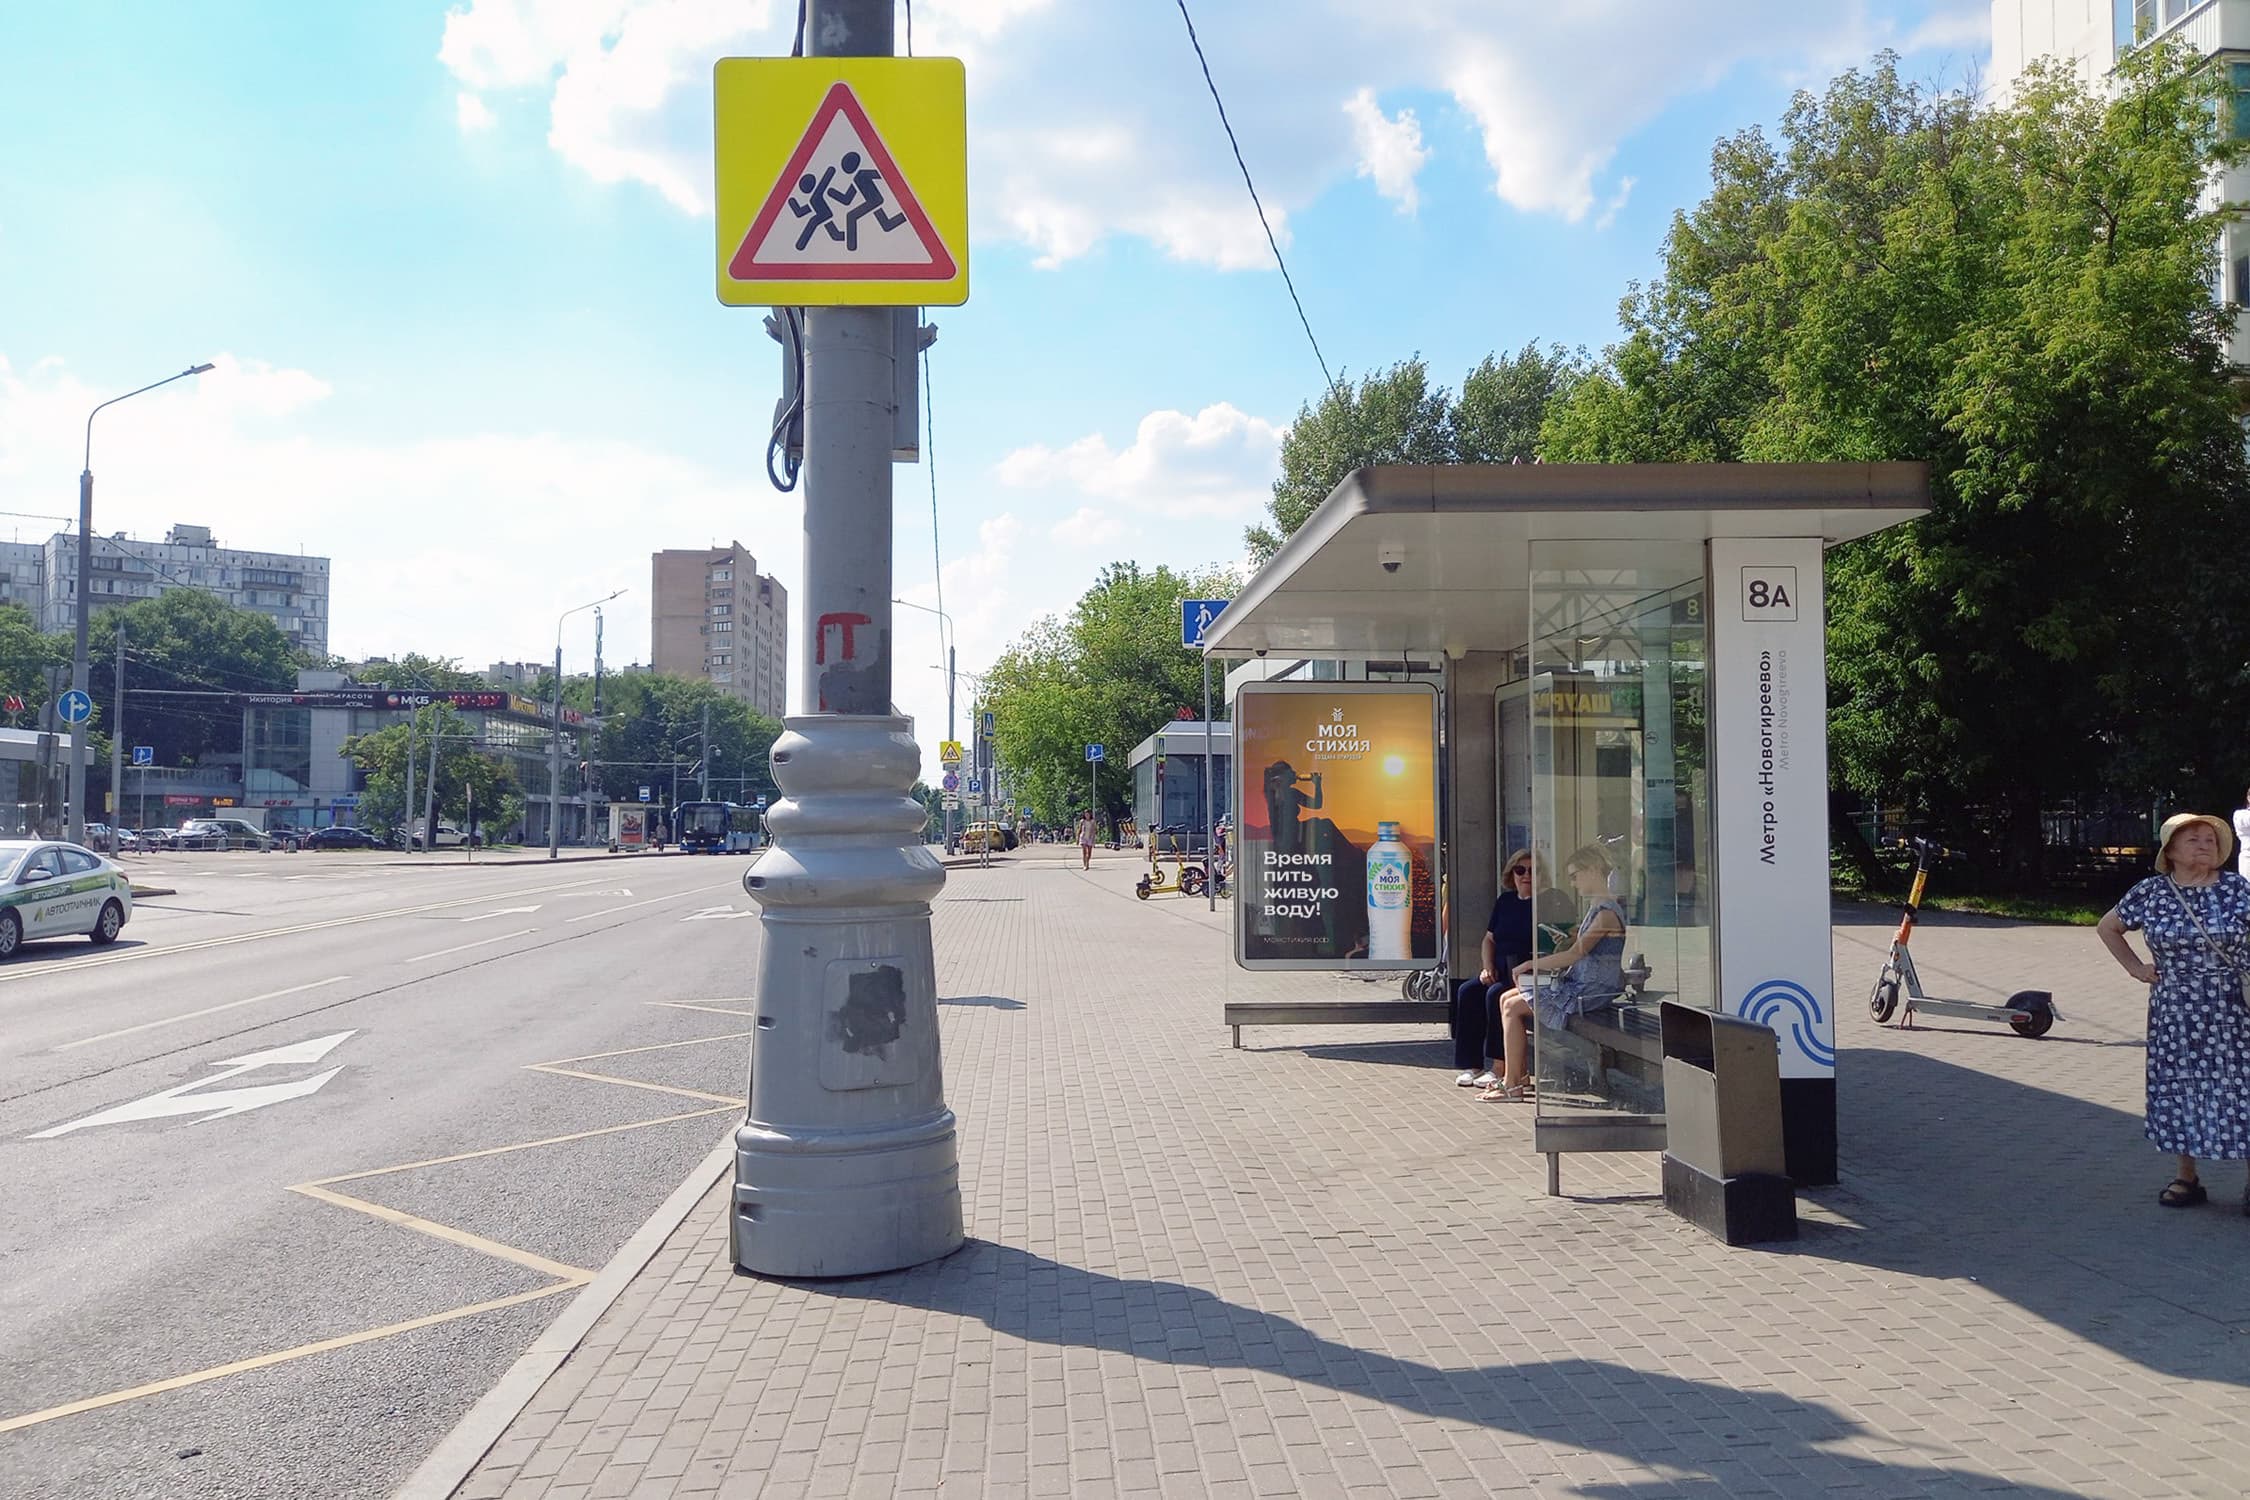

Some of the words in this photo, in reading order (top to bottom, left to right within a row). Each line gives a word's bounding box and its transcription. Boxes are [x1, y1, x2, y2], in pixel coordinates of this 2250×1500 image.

[1748, 580, 1791, 608] 8А
[1778, 649, 1791, 727] Novogireevo
[401, 695, 429, 704] МКБ
[1318, 724, 1357, 737] МОЯ
[1758, 650, 1776, 796] «Новогиреево»
[1306, 740, 1370, 752] СТИХИЯ
[1779, 731, 1790, 770] Metro
[1759, 801, 1778, 864] Метро
[1263, 851, 1332, 868] Время
[1263, 871, 1313, 882] пить
[1379, 875, 1400, 883] МОЯ
[1263, 887, 1339, 902] живую
[1263, 902, 1321, 919] воду!
